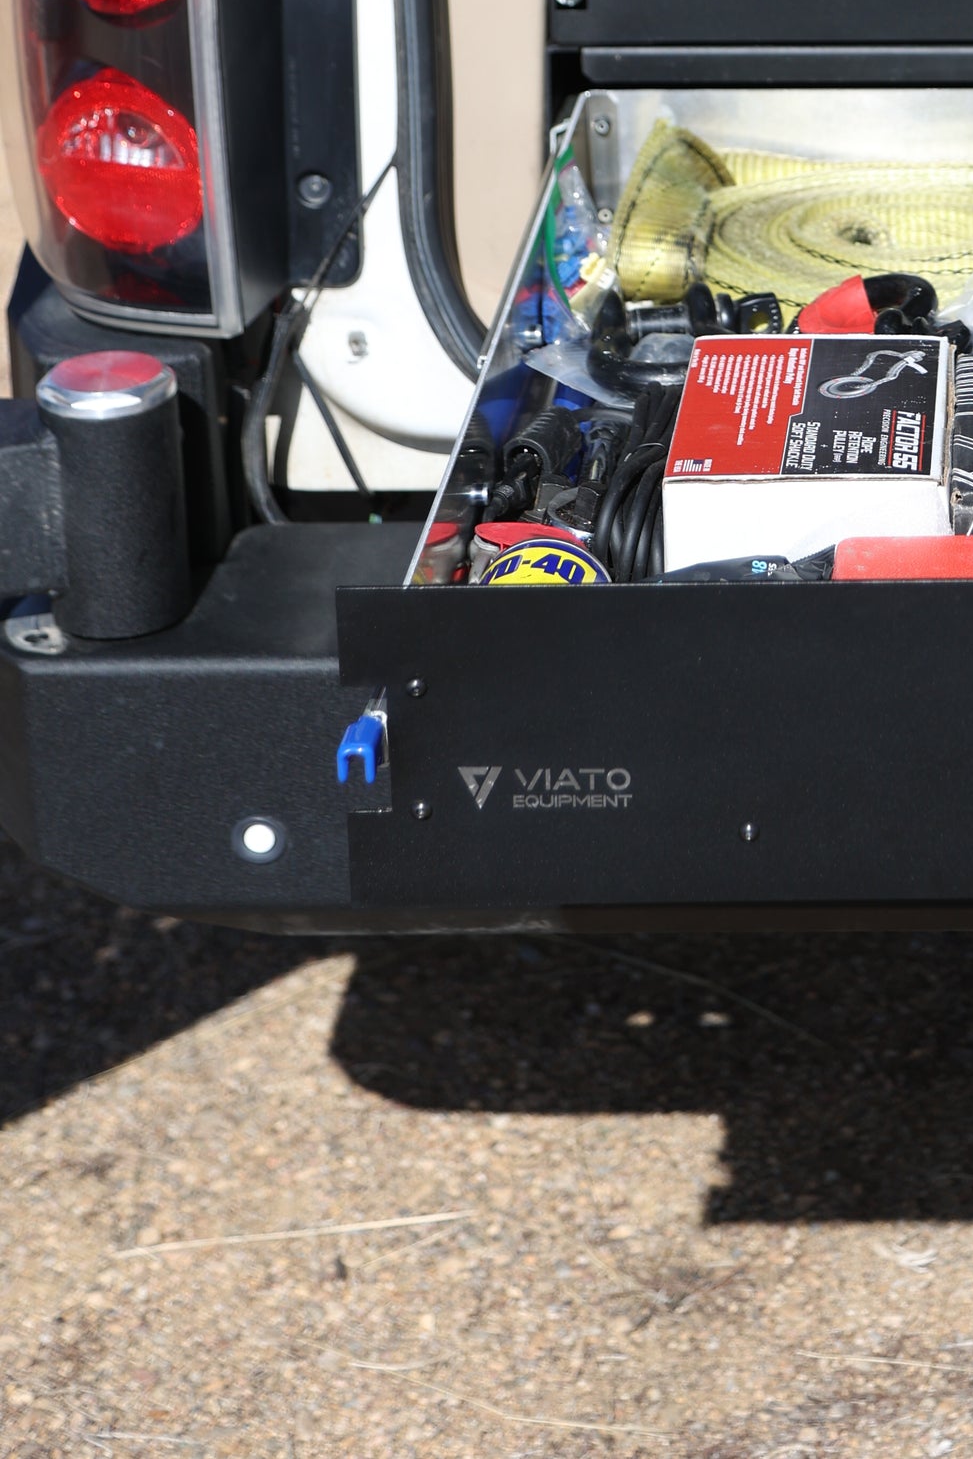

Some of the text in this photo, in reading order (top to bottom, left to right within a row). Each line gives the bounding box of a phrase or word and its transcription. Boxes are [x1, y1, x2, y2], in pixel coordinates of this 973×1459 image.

[790, 422, 806, 439] SOFT
[832, 429, 847, 454] PULLEY
[878, 408, 892, 466] PRECISION ENGINEERING
[892, 410, 921, 471] FACTOR 55
[785, 438, 803, 468] SHACKLE
[800, 421, 821, 471] STANDARD DUTY
[846, 430, 863, 464] RETENTION
[860, 435, 877, 454] ROPE
[514, 767, 632, 791] VIATO
[512, 794, 633, 808] EQUIPMENT
